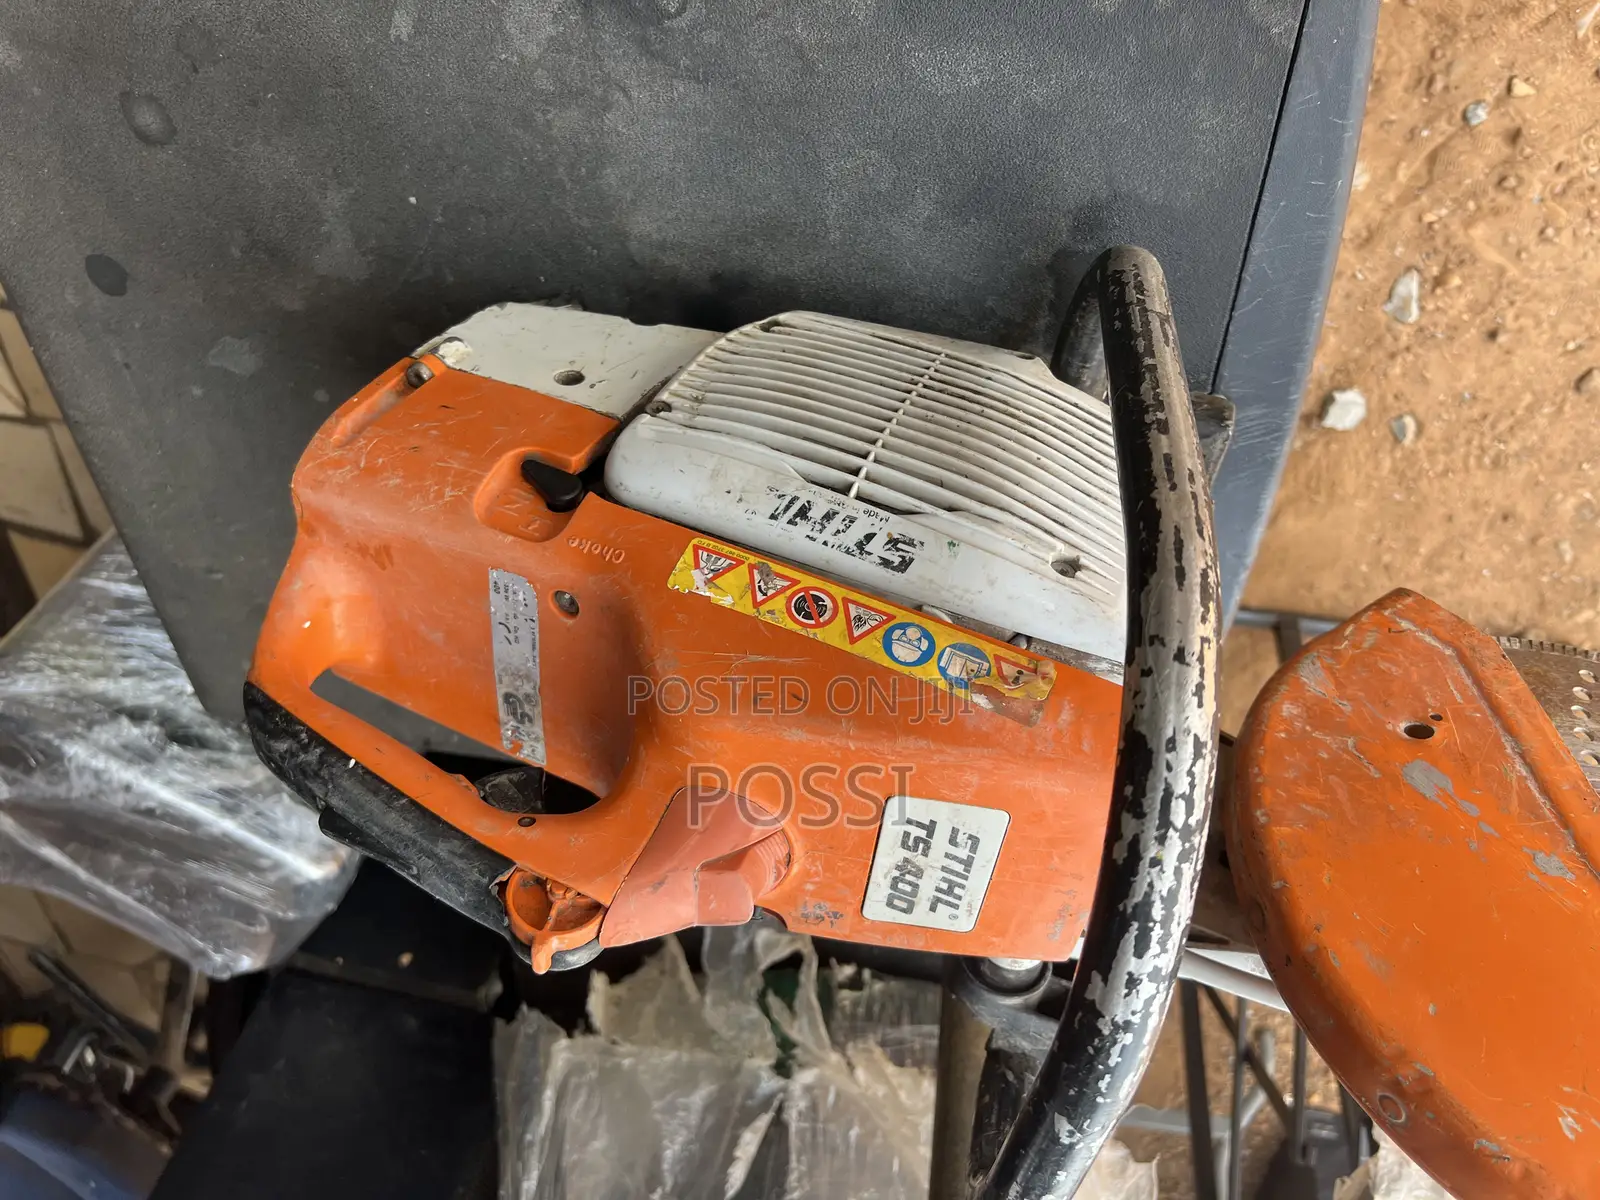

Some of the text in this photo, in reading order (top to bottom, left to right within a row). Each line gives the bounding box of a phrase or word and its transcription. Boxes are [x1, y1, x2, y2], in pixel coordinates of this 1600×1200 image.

[568, 535, 626, 564] Choke
[885, 816, 938, 915] TS 400
